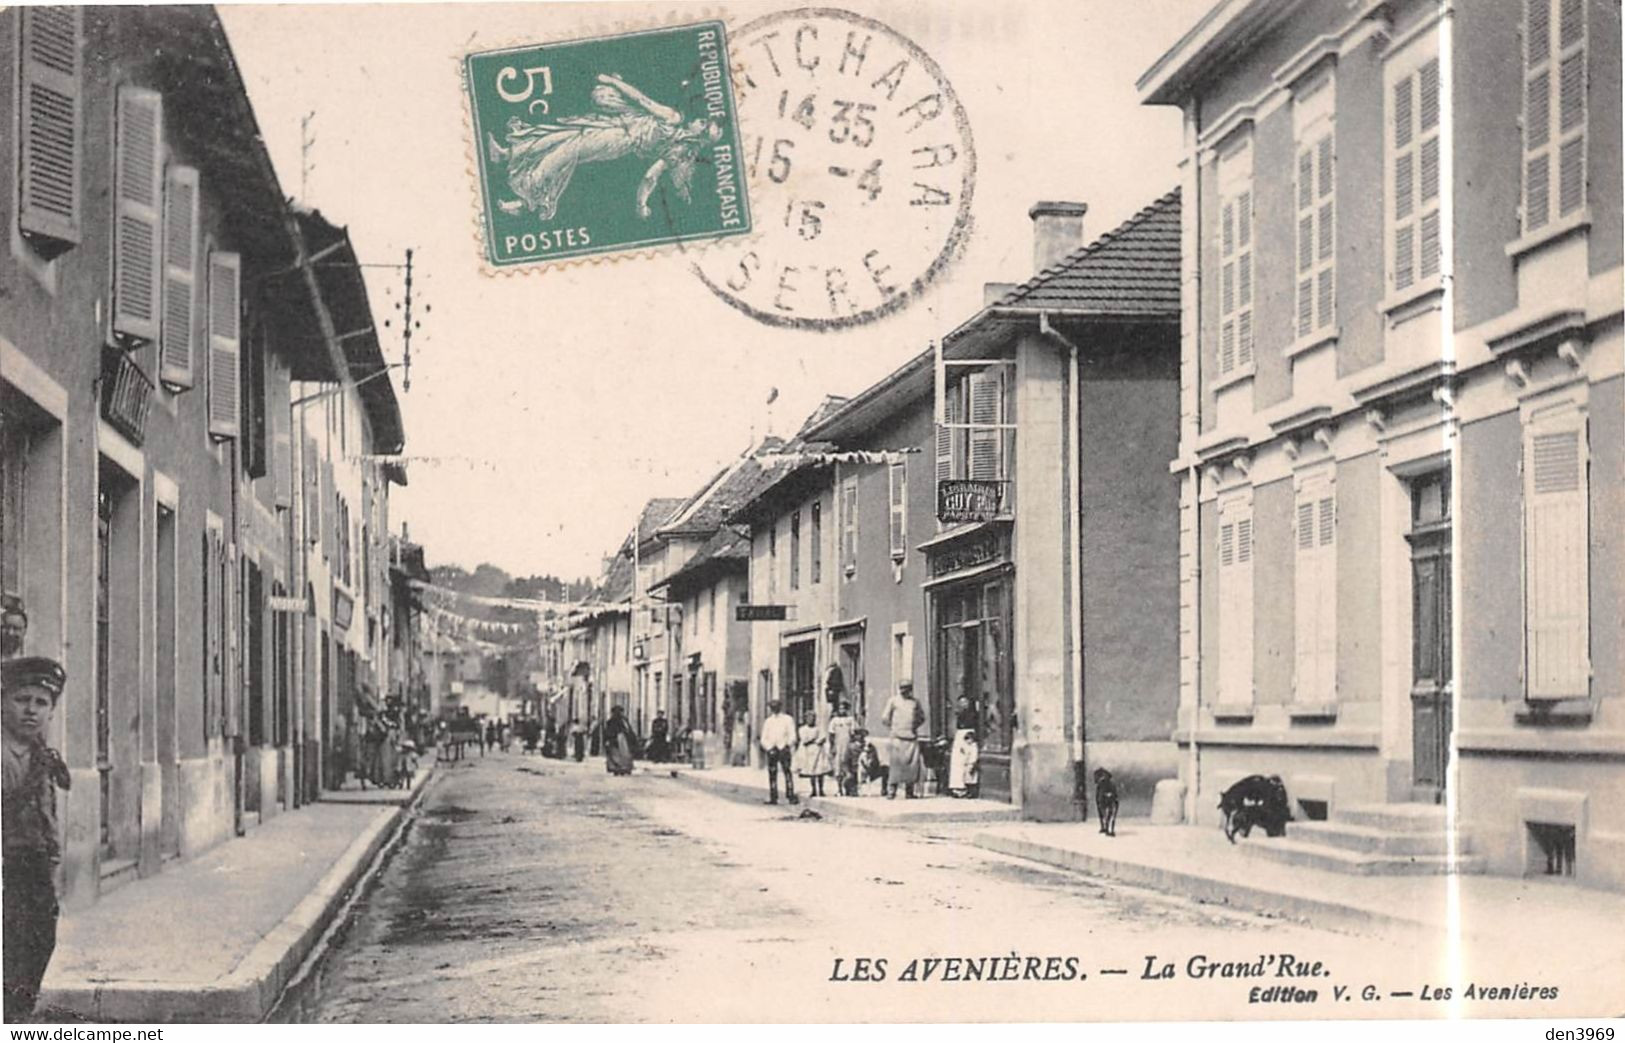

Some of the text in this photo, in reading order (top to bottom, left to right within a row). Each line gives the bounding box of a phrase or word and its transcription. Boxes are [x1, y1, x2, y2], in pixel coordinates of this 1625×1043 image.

[744, 25, 957, 206] TCHARRA
[828, 99, 877, 148] 35
[713, 144, 740, 228] FRANÇAISE
[505, 227, 591, 254] POSTES
